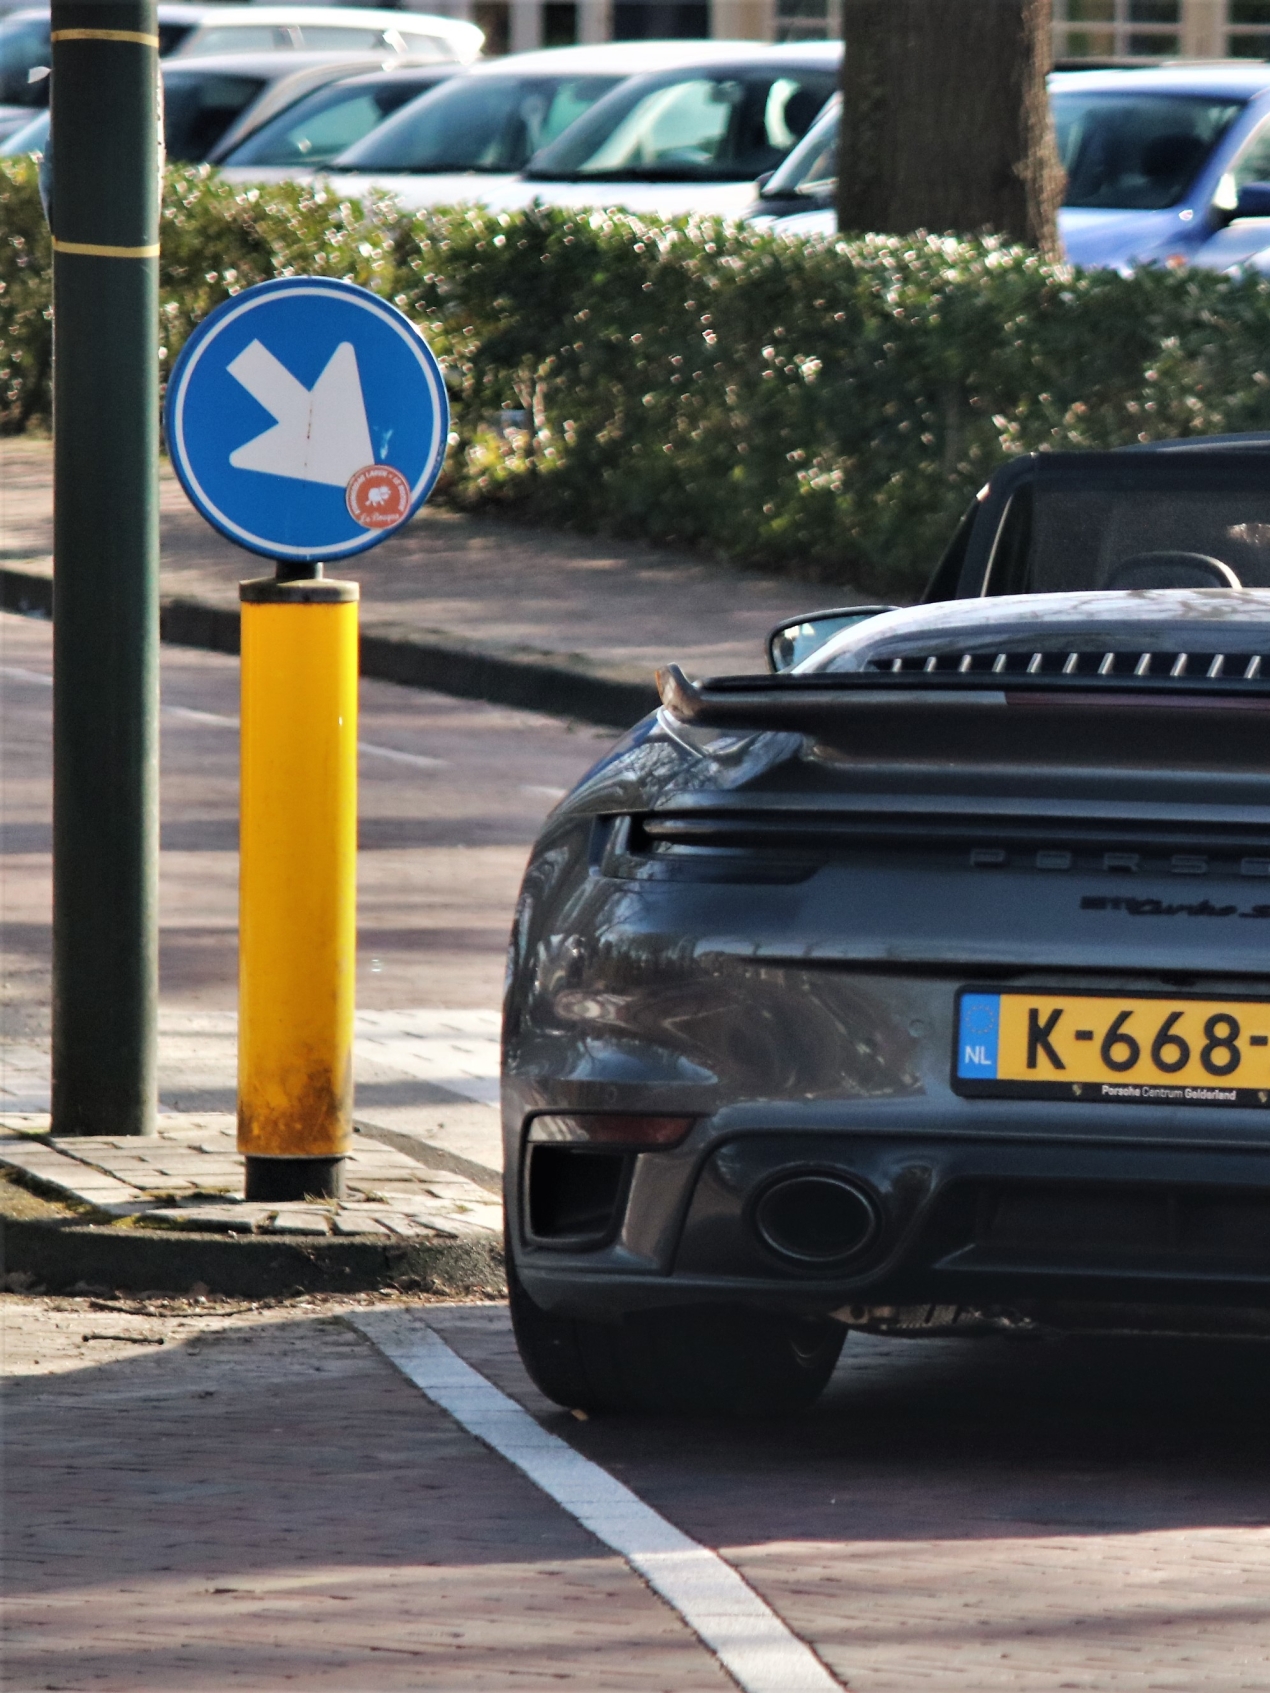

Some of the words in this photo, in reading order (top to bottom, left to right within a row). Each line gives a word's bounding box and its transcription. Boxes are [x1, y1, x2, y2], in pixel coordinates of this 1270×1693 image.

[965, 1046, 992, 1065] NL
[1102, 1084, 1140, 1097] Porsche
[1142, 1086, 1183, 1098] Centrum
[1184, 1088, 1237, 1101] Gelderland
